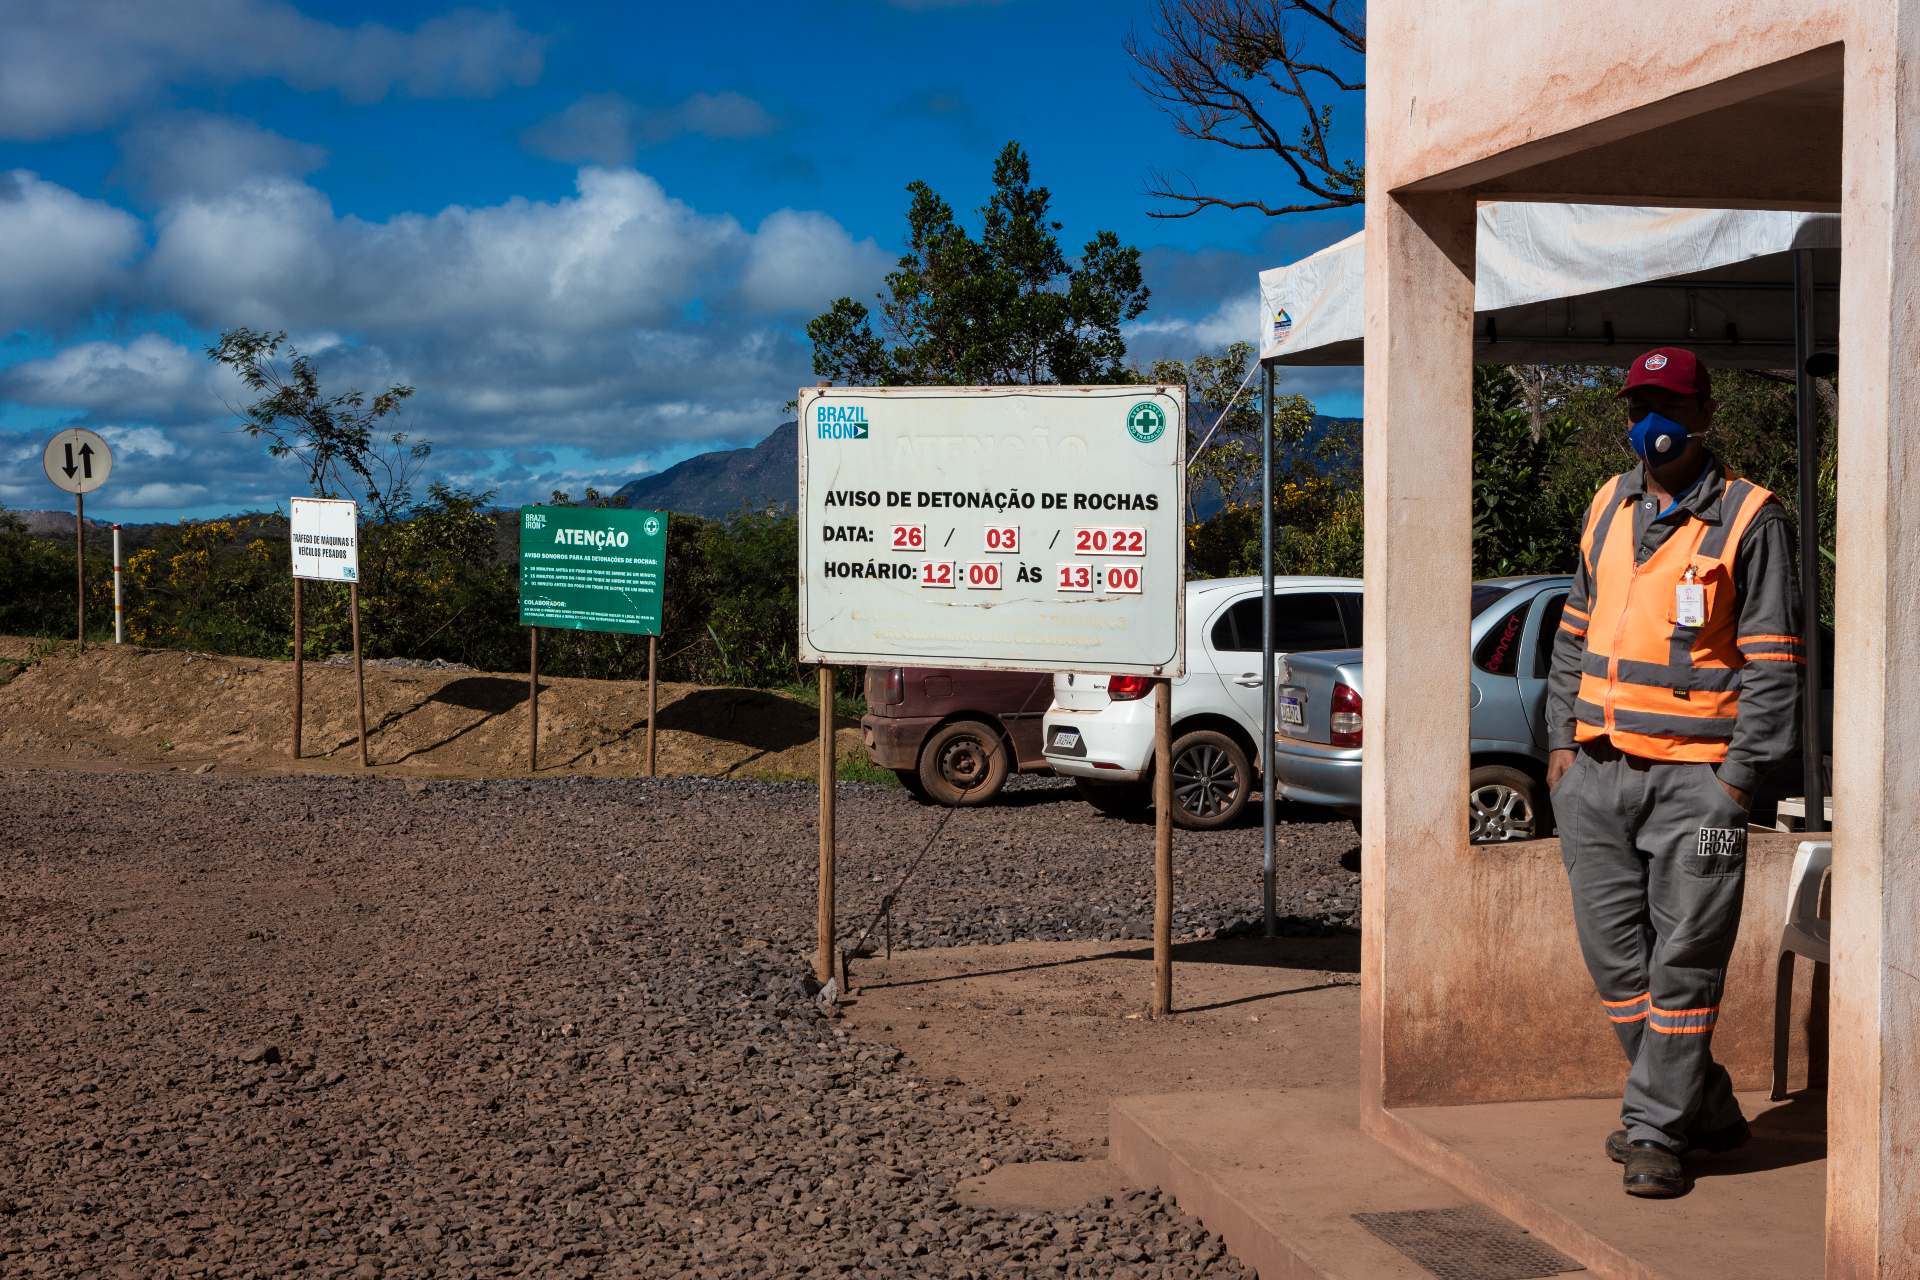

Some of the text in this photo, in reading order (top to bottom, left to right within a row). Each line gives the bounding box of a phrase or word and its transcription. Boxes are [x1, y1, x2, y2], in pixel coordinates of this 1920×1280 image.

[818, 406, 868, 422] BRAZIL
[818, 423, 852, 439] IRON
[824, 488, 1159, 513] AVISO DE DETONAÇÃO DE ROCHAS
[525, 514, 546, 522] BRAZIL
[292, 533, 354, 547] TRÁFEGO DE MÁQUINAS E
[554, 526, 629, 550] ATENÇÃO
[823, 526, 874, 542] DATA:
[894, 526, 922, 547] 26
[986, 528, 1016, 549] 03
[1076, 530, 1143, 552] 2022
[298, 546, 347, 559] VEÍCULOS PESADOS
[824, 558, 917, 580] HORÁRIO:
[1016, 562, 1042, 583] ÀS
[524, 600, 567, 608] COLABORADOR:
[1698, 842, 1731, 854] IRON
